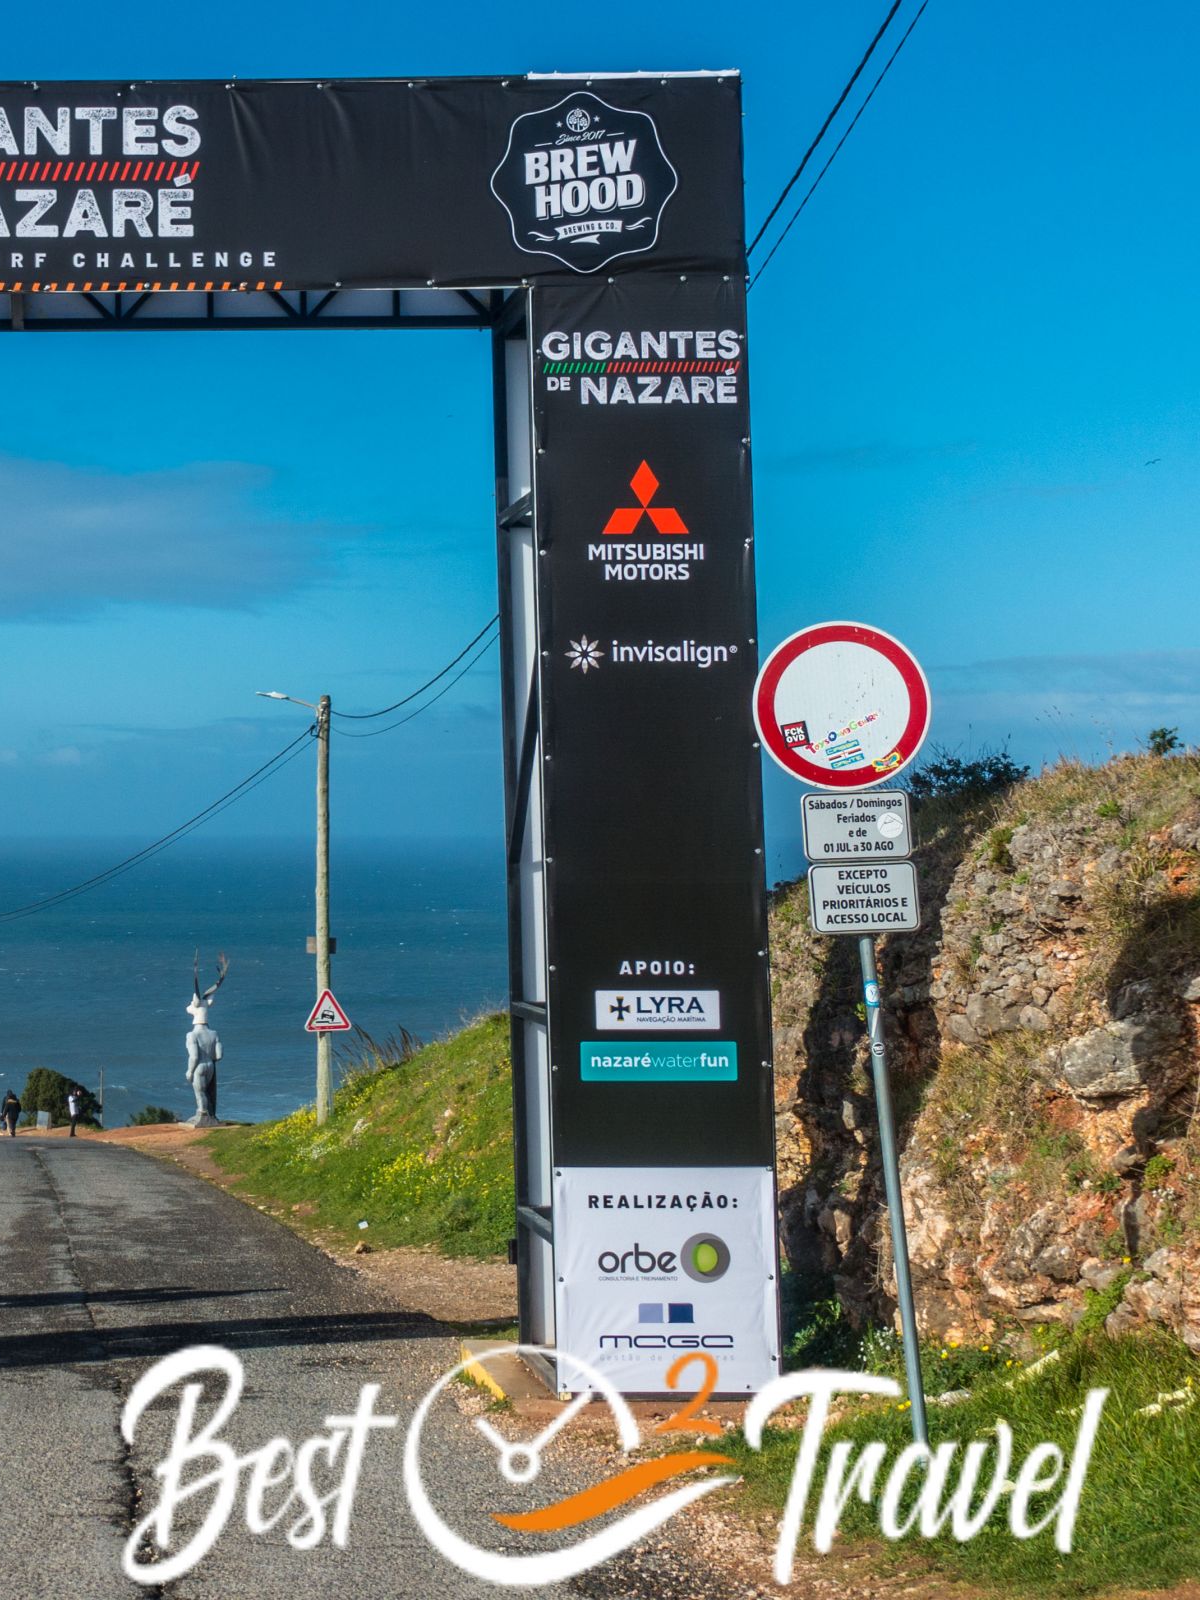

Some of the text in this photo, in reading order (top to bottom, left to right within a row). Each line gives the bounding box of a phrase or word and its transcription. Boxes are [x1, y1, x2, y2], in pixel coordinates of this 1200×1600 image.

[555, 130, 606, 146] Since 2017
[524, 139, 637, 185] BREW
[534, 173, 646, 221] HOOD
[563, 222, 595, 236] BREWING
[605, 221, 618, 231] CO.
[73, 251, 277, 269] CHALLENGE
[541, 329, 740, 361] GIGANTES
[547, 367, 737, 404] DE NAZARÉ
[588, 543, 704, 560] MITSUBISHI
[604, 564, 690, 580] MOTORS
[785, 726, 804, 736] FCK
[808, 800, 848, 810] Sábados
[857, 798, 902, 809] Domingos
[837, 813, 877, 823] Feriados
[856, 828, 867, 837] de
[824, 843, 834, 853] 01
[836, 842, 851, 852] JUL
[861, 842, 872, 851] 30
[874, 841, 894, 851] AGO
[838, 869, 887, 880] EXCEPTO
[837, 883, 891, 895] VEÍCULOS
[822, 897, 908, 910] PRIORITÁRIOS E
[826, 912, 907, 924] ACESSO LOCAL
[619, 960, 695, 975] APOIO:
[636, 996, 705, 1013] LYRA
[636, 1015, 676, 1024] NAVEGAÇÃO
[588, 1192, 738, 1212] REALIZAÇÃO:
[598, 1242, 677, 1273] orbe
